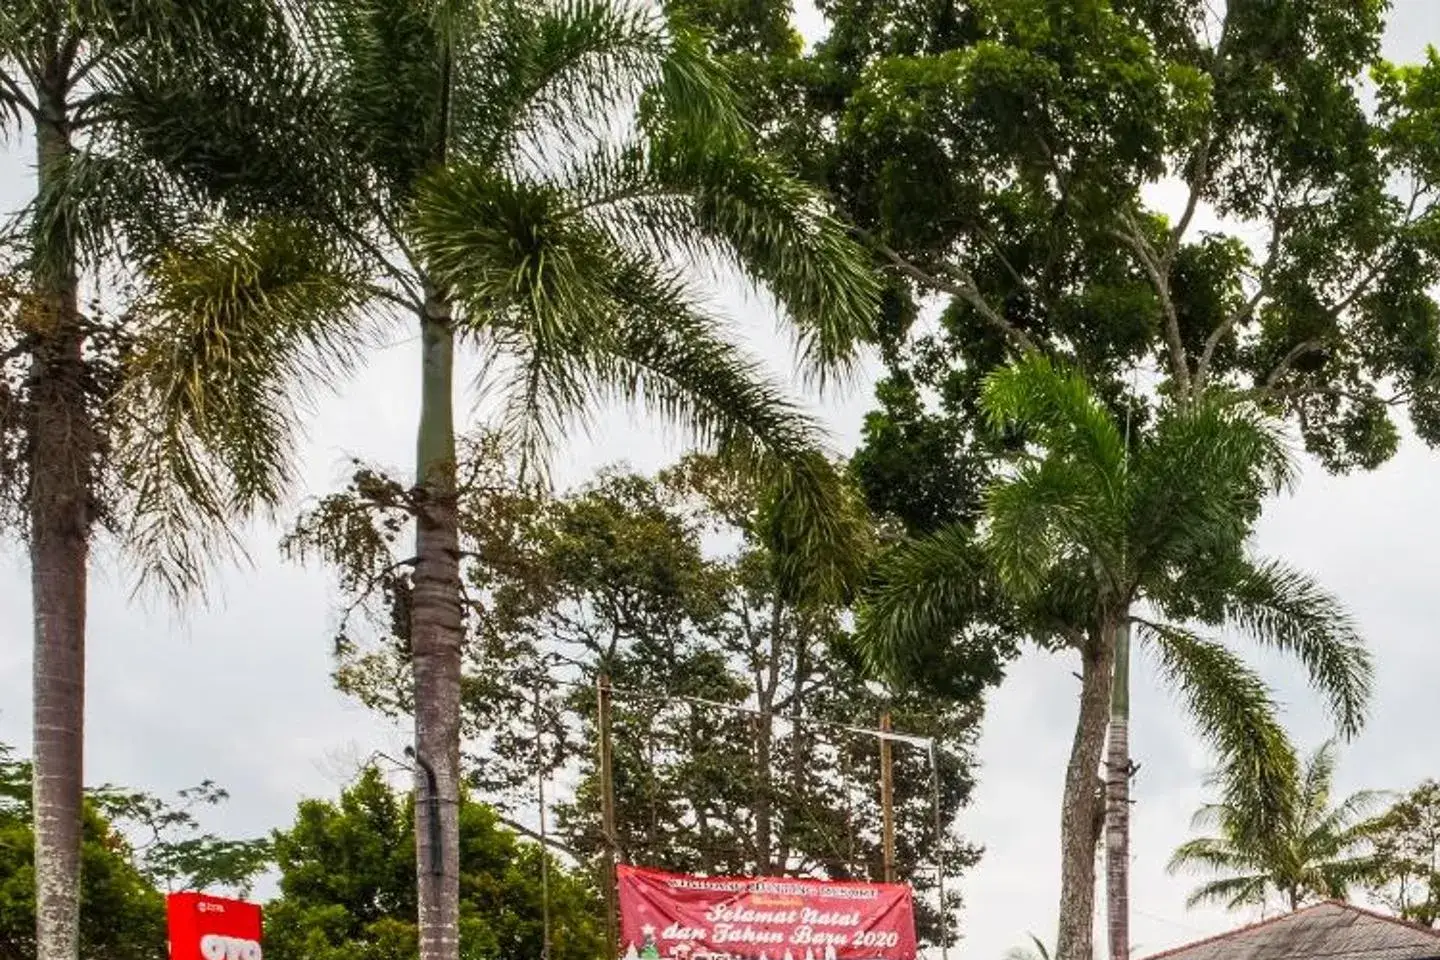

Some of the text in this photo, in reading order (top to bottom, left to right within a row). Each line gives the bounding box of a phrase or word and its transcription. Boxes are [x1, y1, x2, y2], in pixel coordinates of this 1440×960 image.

[706, 905, 860, 926] Selamat Natal
[662, 922, 899, 948] dan Tahun Baru 2020
